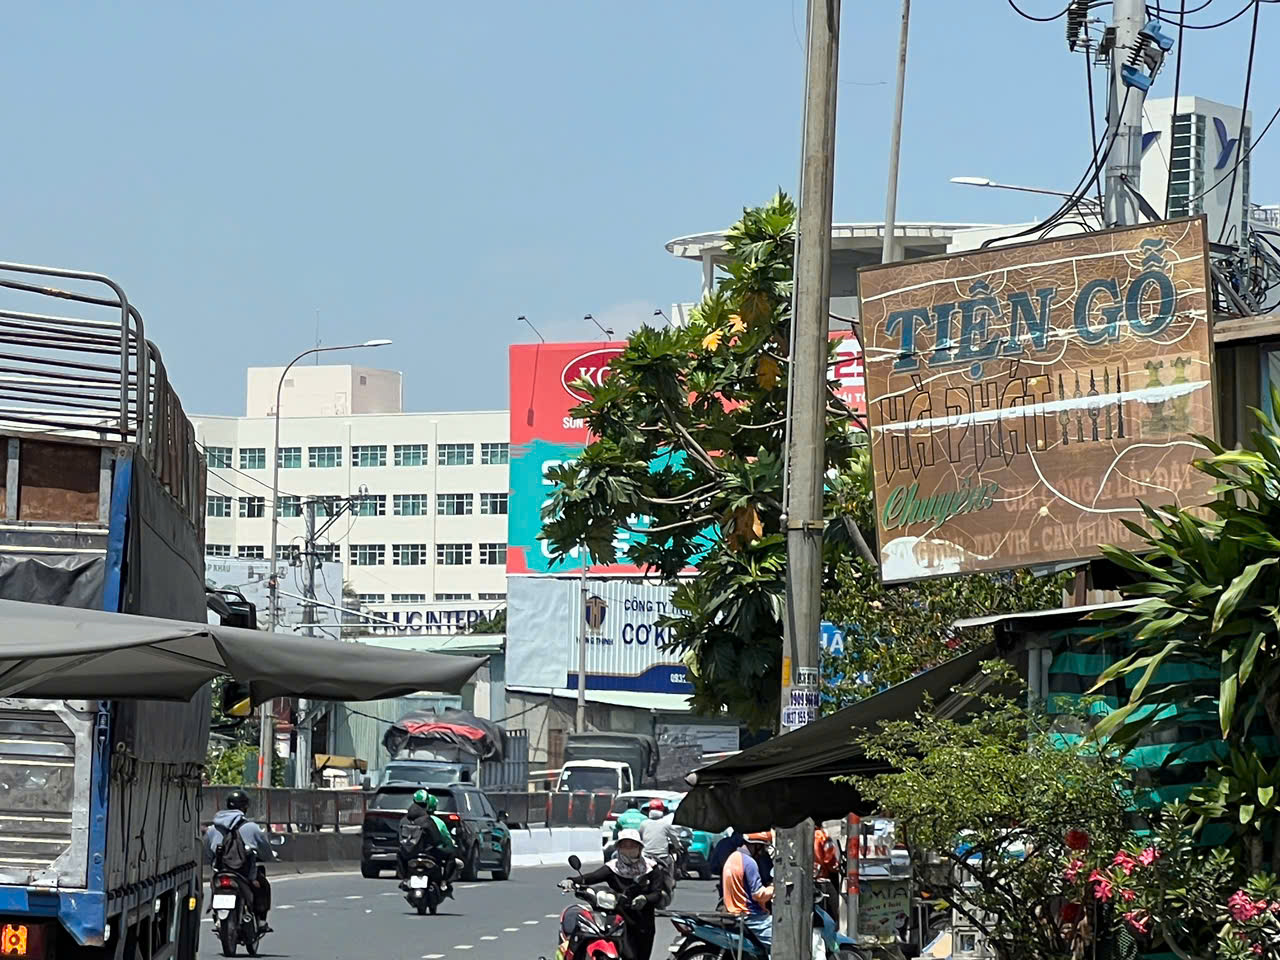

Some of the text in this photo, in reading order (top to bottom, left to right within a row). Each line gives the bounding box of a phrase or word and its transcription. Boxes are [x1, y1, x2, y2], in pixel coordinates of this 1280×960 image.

[885, 238, 1176, 379] TIỆN GỖ
[945, 361, 1052, 472] PHÁT
[624, 597, 653, 612] CÔNG
[656, 602, 667, 614] TY
